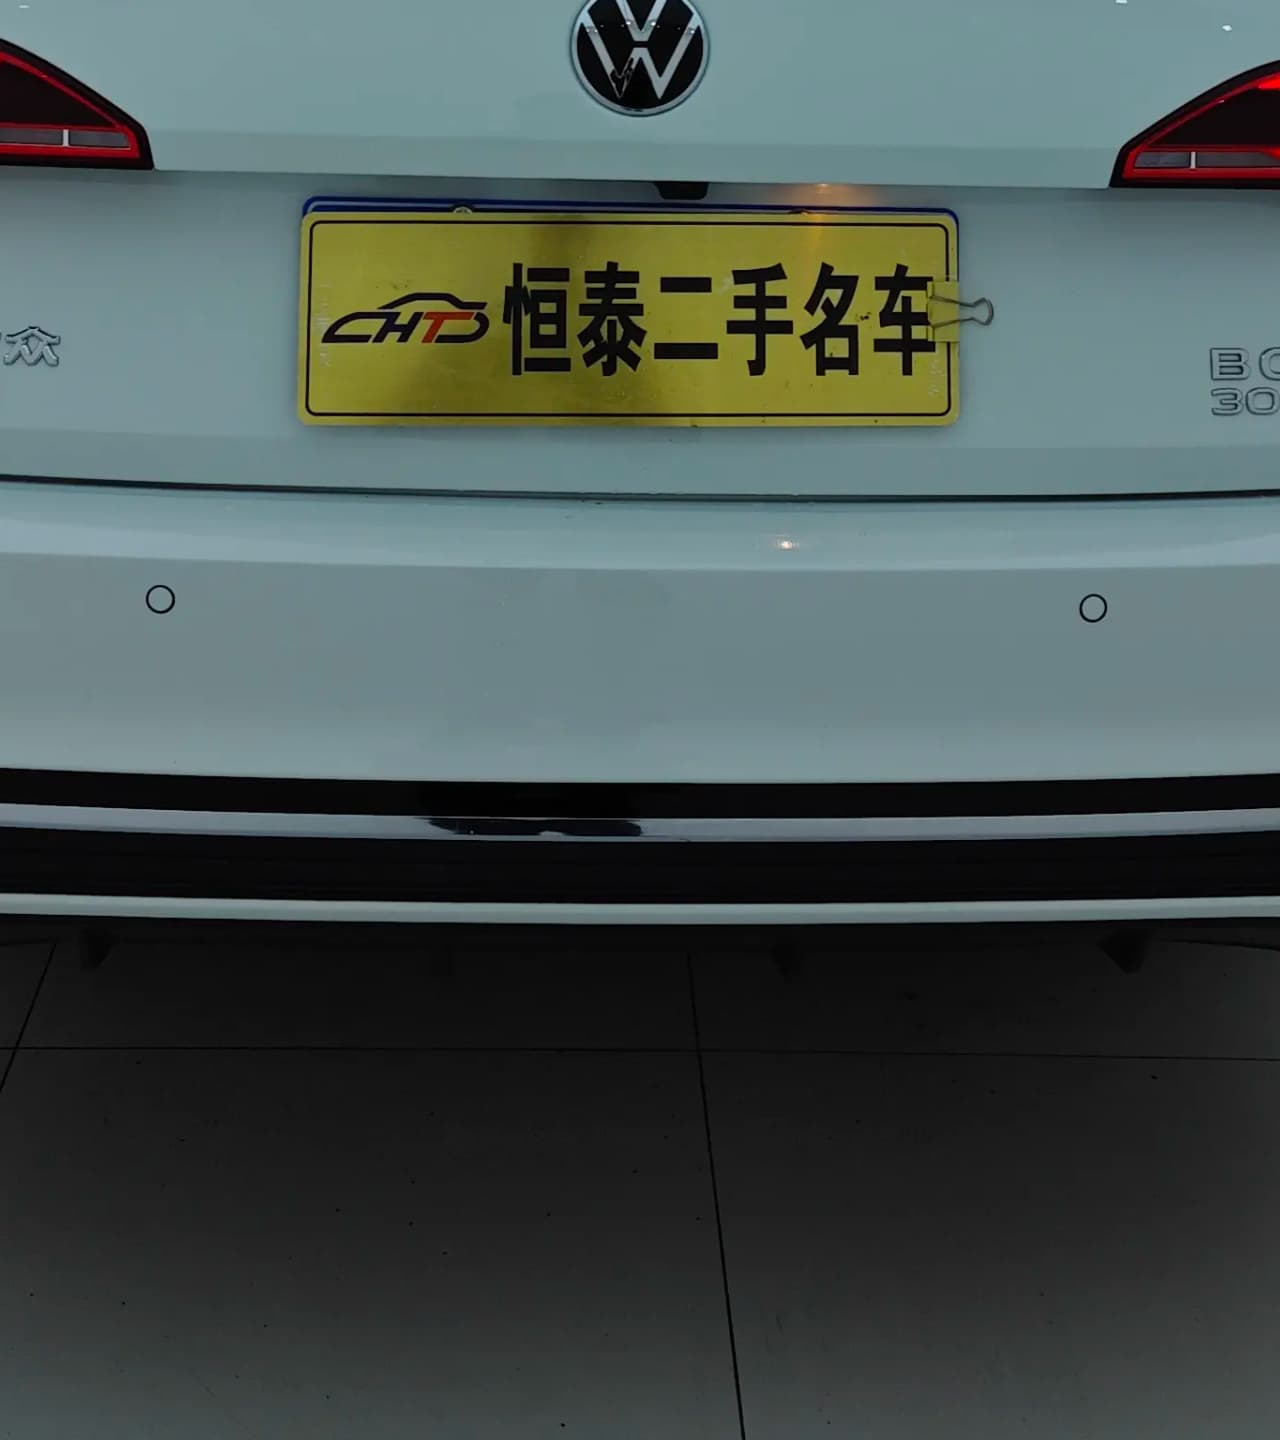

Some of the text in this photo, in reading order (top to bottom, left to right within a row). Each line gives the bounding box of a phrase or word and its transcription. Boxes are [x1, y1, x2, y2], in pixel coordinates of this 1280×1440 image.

[503, 261, 936, 377] 恒泰二手名车
